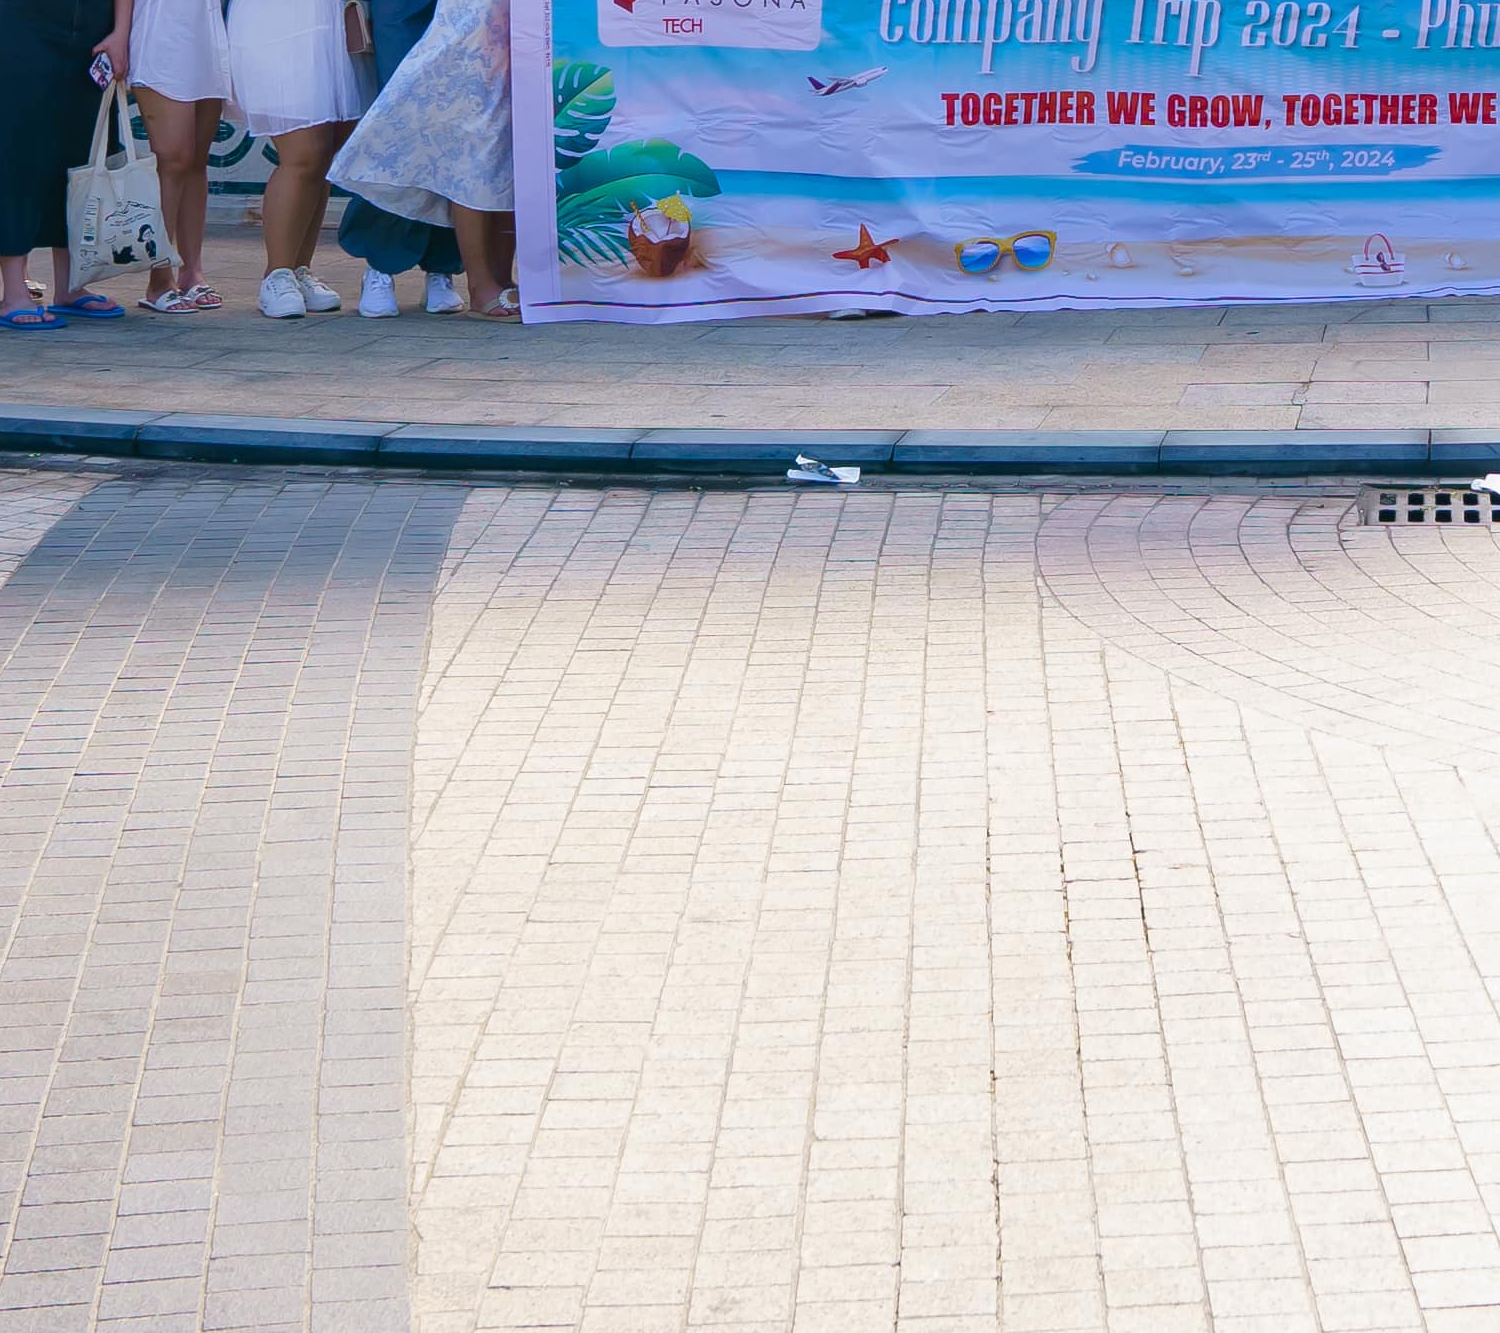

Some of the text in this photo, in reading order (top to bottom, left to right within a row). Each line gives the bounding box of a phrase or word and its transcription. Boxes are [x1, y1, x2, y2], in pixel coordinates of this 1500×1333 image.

[662, 17, 703, 34] TECH
[1240, 0, 1361, 50] 2024
[941, 91, 1095, 127] TOGETHER
[1106, 92, 1156, 126] WE
[1167, 94, 1272, 130] GROW,
[1283, 93, 1438, 127] TOGETHER
[1448, 92, 1497, 126] WE
[1117, 150, 1226, 174] February,
[1231, 151, 1272, 170] 23rd
[1290, 149, 1334, 173] 25th,
[1340, 148, 1396, 167] 2024
